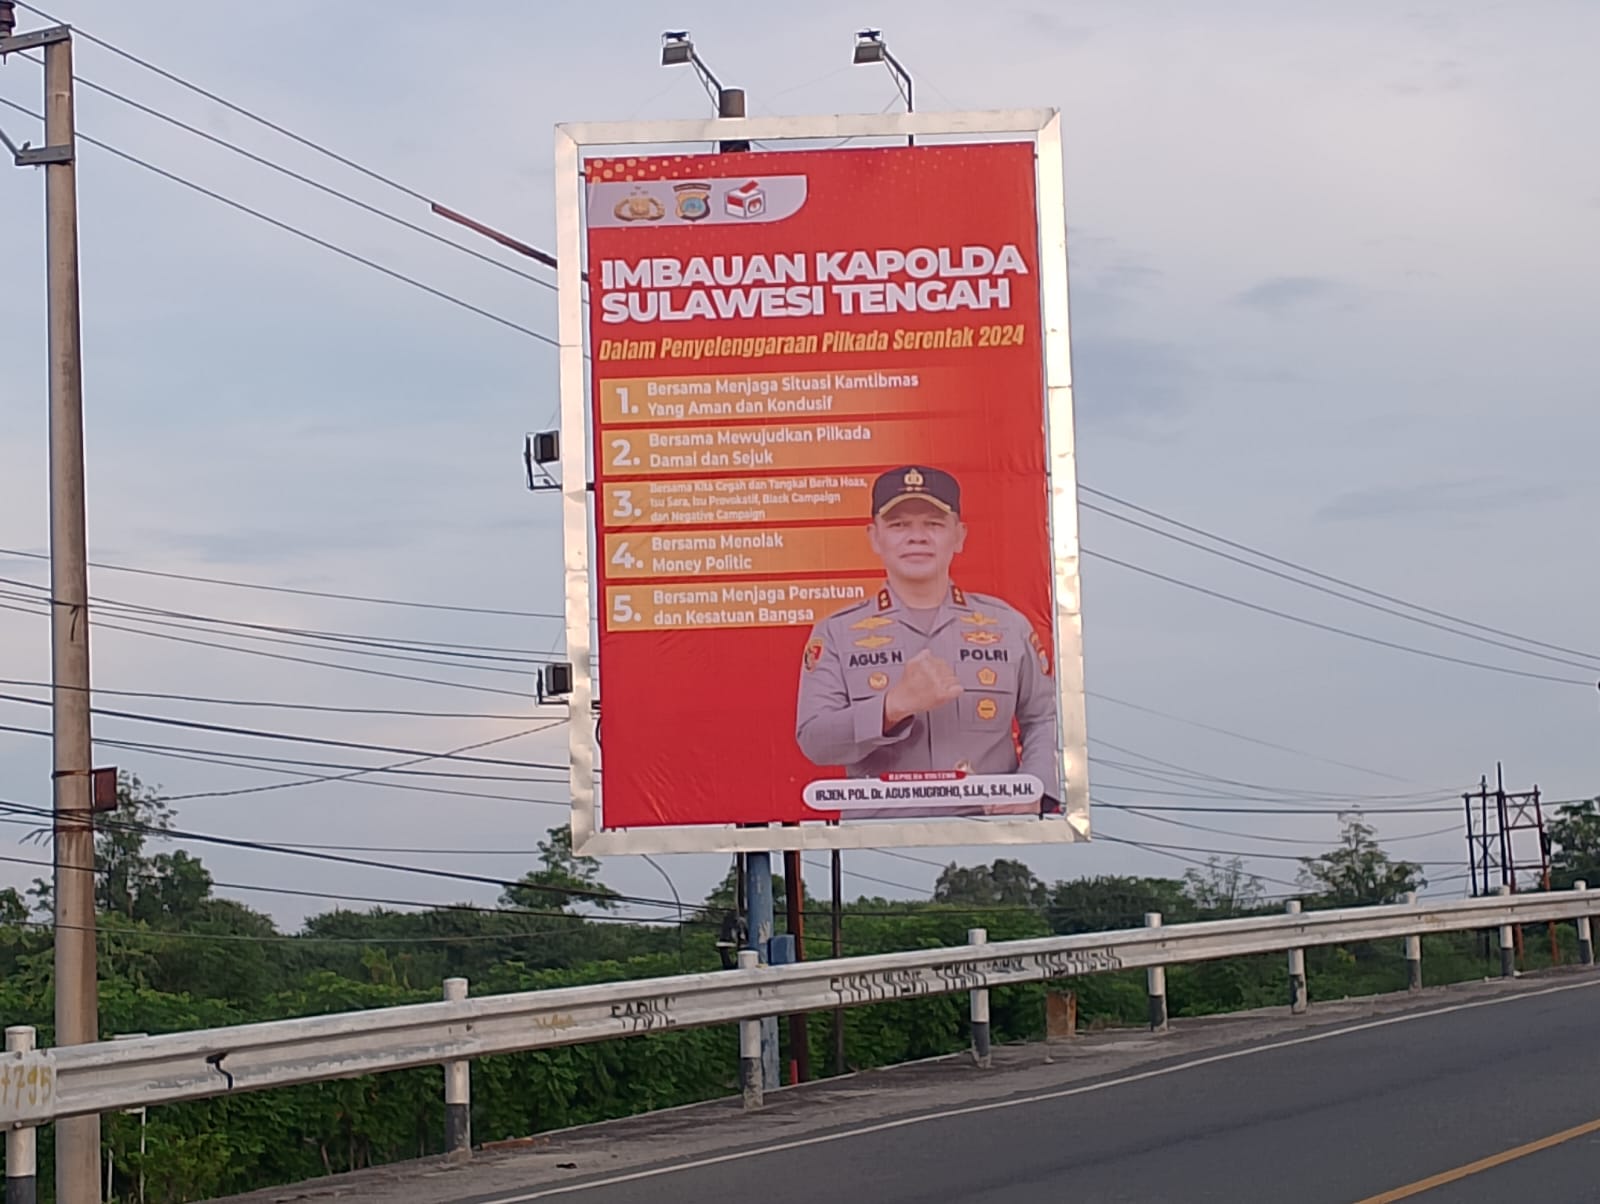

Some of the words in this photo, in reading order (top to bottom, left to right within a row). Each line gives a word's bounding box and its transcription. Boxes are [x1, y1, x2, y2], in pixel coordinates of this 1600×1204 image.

[601, 253, 806, 289] IMBAUAN
[816, 245, 1028, 282] KAPOLDA
[602, 286, 824, 323] SULAWESI
[832, 278, 1010, 314] TENGAH
[599, 339, 656, 360] Dalam
[660, 335, 818, 359] Penyelenggaraan
[822, 331, 888, 352] Pilkada
[893, 327, 973, 349] Serentak
[978, 324, 1025, 347] 2024
[647, 381, 711, 396] Bersama
[716, 378, 778, 397] Menjaga
[782, 376, 830, 391] Situasi
[835, 373, 919, 390] Kamtibmas
[615, 387, 639, 414] 1.
[648, 402, 684, 418] Yang
[688, 401, 732, 415] Aman
[736, 399, 762, 413] dan
[767, 396, 833, 412] Kondusif
[649, 433, 713, 447] Bersama
[717, 428, 813, 446] Mewujudkan
[816, 425, 871, 441] Pilkada
[611, 439, 640, 466] 2.
[650, 453, 697, 468] Damai
[701, 452, 728, 466] dan
[732, 449, 773, 467] Sejuk
[612, 490, 641, 517] 3.
[652, 536, 716, 551] Bersama
[721, 533, 784, 549] Menolak
[612, 543, 644, 569] 4.
[653, 558, 702, 574] Money
[706, 555, 752, 569] Politic
[654, 589, 718, 604] Bersama
[722, 586, 785, 605] Menjaga
[789, 585, 864, 600] Persatuan
[613, 595, 642, 622] 5.
[654, 609, 682, 625] dan
[686, 607, 755, 623] Kesatuan
[759, 606, 814, 623] Bangsa
[849, 652, 888, 668] AGUS
[892, 650, 903, 663] N
[960, 649, 1008, 662] POLRI
[885, 787, 911, 799] AGUS
[912, 785, 961, 800] NUGROHO,
